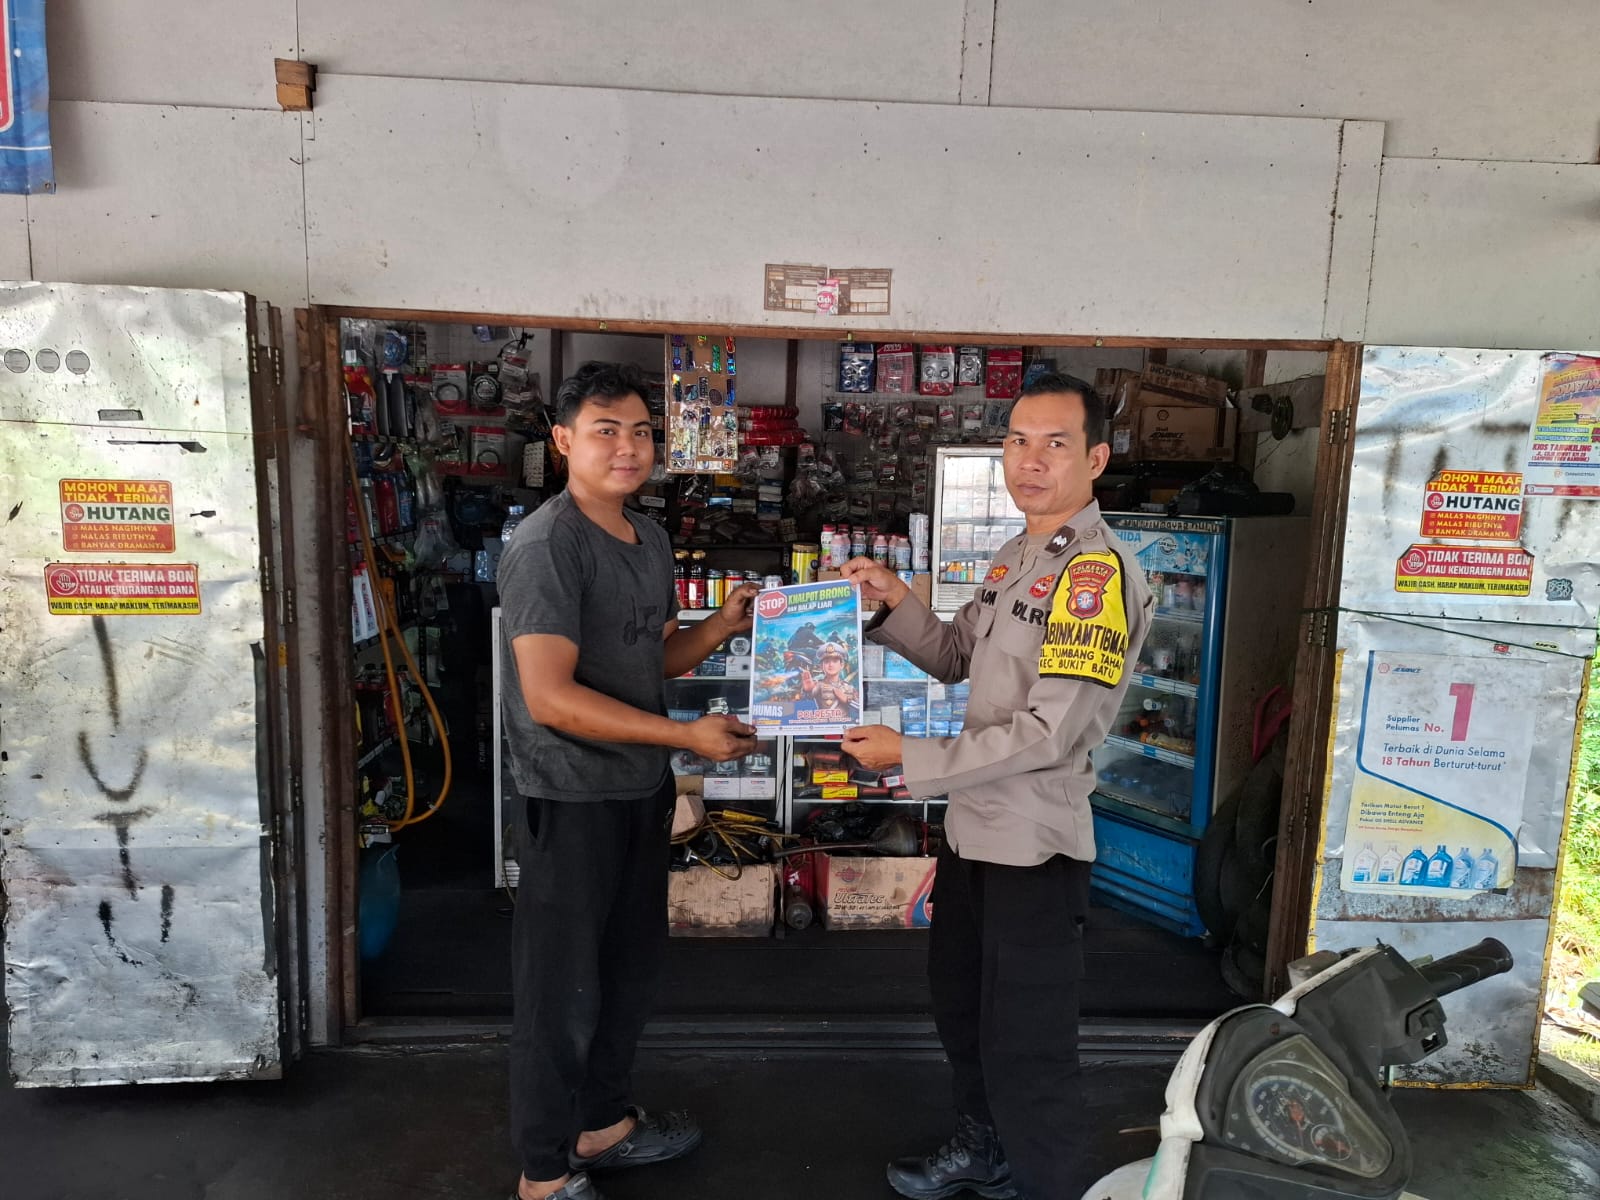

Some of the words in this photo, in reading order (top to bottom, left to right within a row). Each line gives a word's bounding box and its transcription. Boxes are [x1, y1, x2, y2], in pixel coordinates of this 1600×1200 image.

[1484, 474, 1522, 484] MAAF
[64, 482, 118, 493] MOHON
[124, 483, 167, 494] MAAF
[1429, 482, 1468, 492] TIDAK
[1474, 484, 1521, 494] TERIMA
[64, 492, 108, 502] TIDAK
[114, 493, 168, 503] TERIMA
[1446, 496, 1520, 511] HUTANG
[87, 507, 170, 521] HUTANG
[1426, 550, 1459, 562] TIDAK
[1463, 552, 1505, 564] TERIMA
[1508, 553, 1530, 566] BON
[77, 570, 113, 582] TIDAK
[116, 570, 165, 582] TERIMA
[168, 570, 194, 582] BON
[1425, 565, 1446, 574] ATAU
[1448, 566, 1503, 576] KEKURANGAN
[1505, 568, 1528, 577] DANA
[79, 584, 103, 594] ATAU
[105, 585, 166, 594] KEKURANGAN
[170, 585, 195, 594] DANA
[819, 586, 851, 601] BRONG
[759, 597, 785, 611] STOP
[817, 600, 833, 609] LIAR
[1042, 622, 1128, 658] ABINKAMTIBMA
[1051, 648, 1094, 660] TUMBANG
[1058, 659, 1086, 670] BUKIT
[1091, 664, 1114, 678] BATU
[753, 704, 783, 716] HUMAS
[1448, 683, 1475, 742] 1
[1387, 715, 1420, 724] Supplier
[1386, 724, 1420, 732] Pelumas
[1424, 723, 1445, 733] No.
[1384, 743, 1420, 754] Terbaik
[1423, 744, 1432, 755] di
[1435, 746, 1464, 757] Dunia
[1467, 747, 1505, 758] Selama
[1382, 756, 1392, 765] 18
[1396, 756, 1430, 767] Tahun
